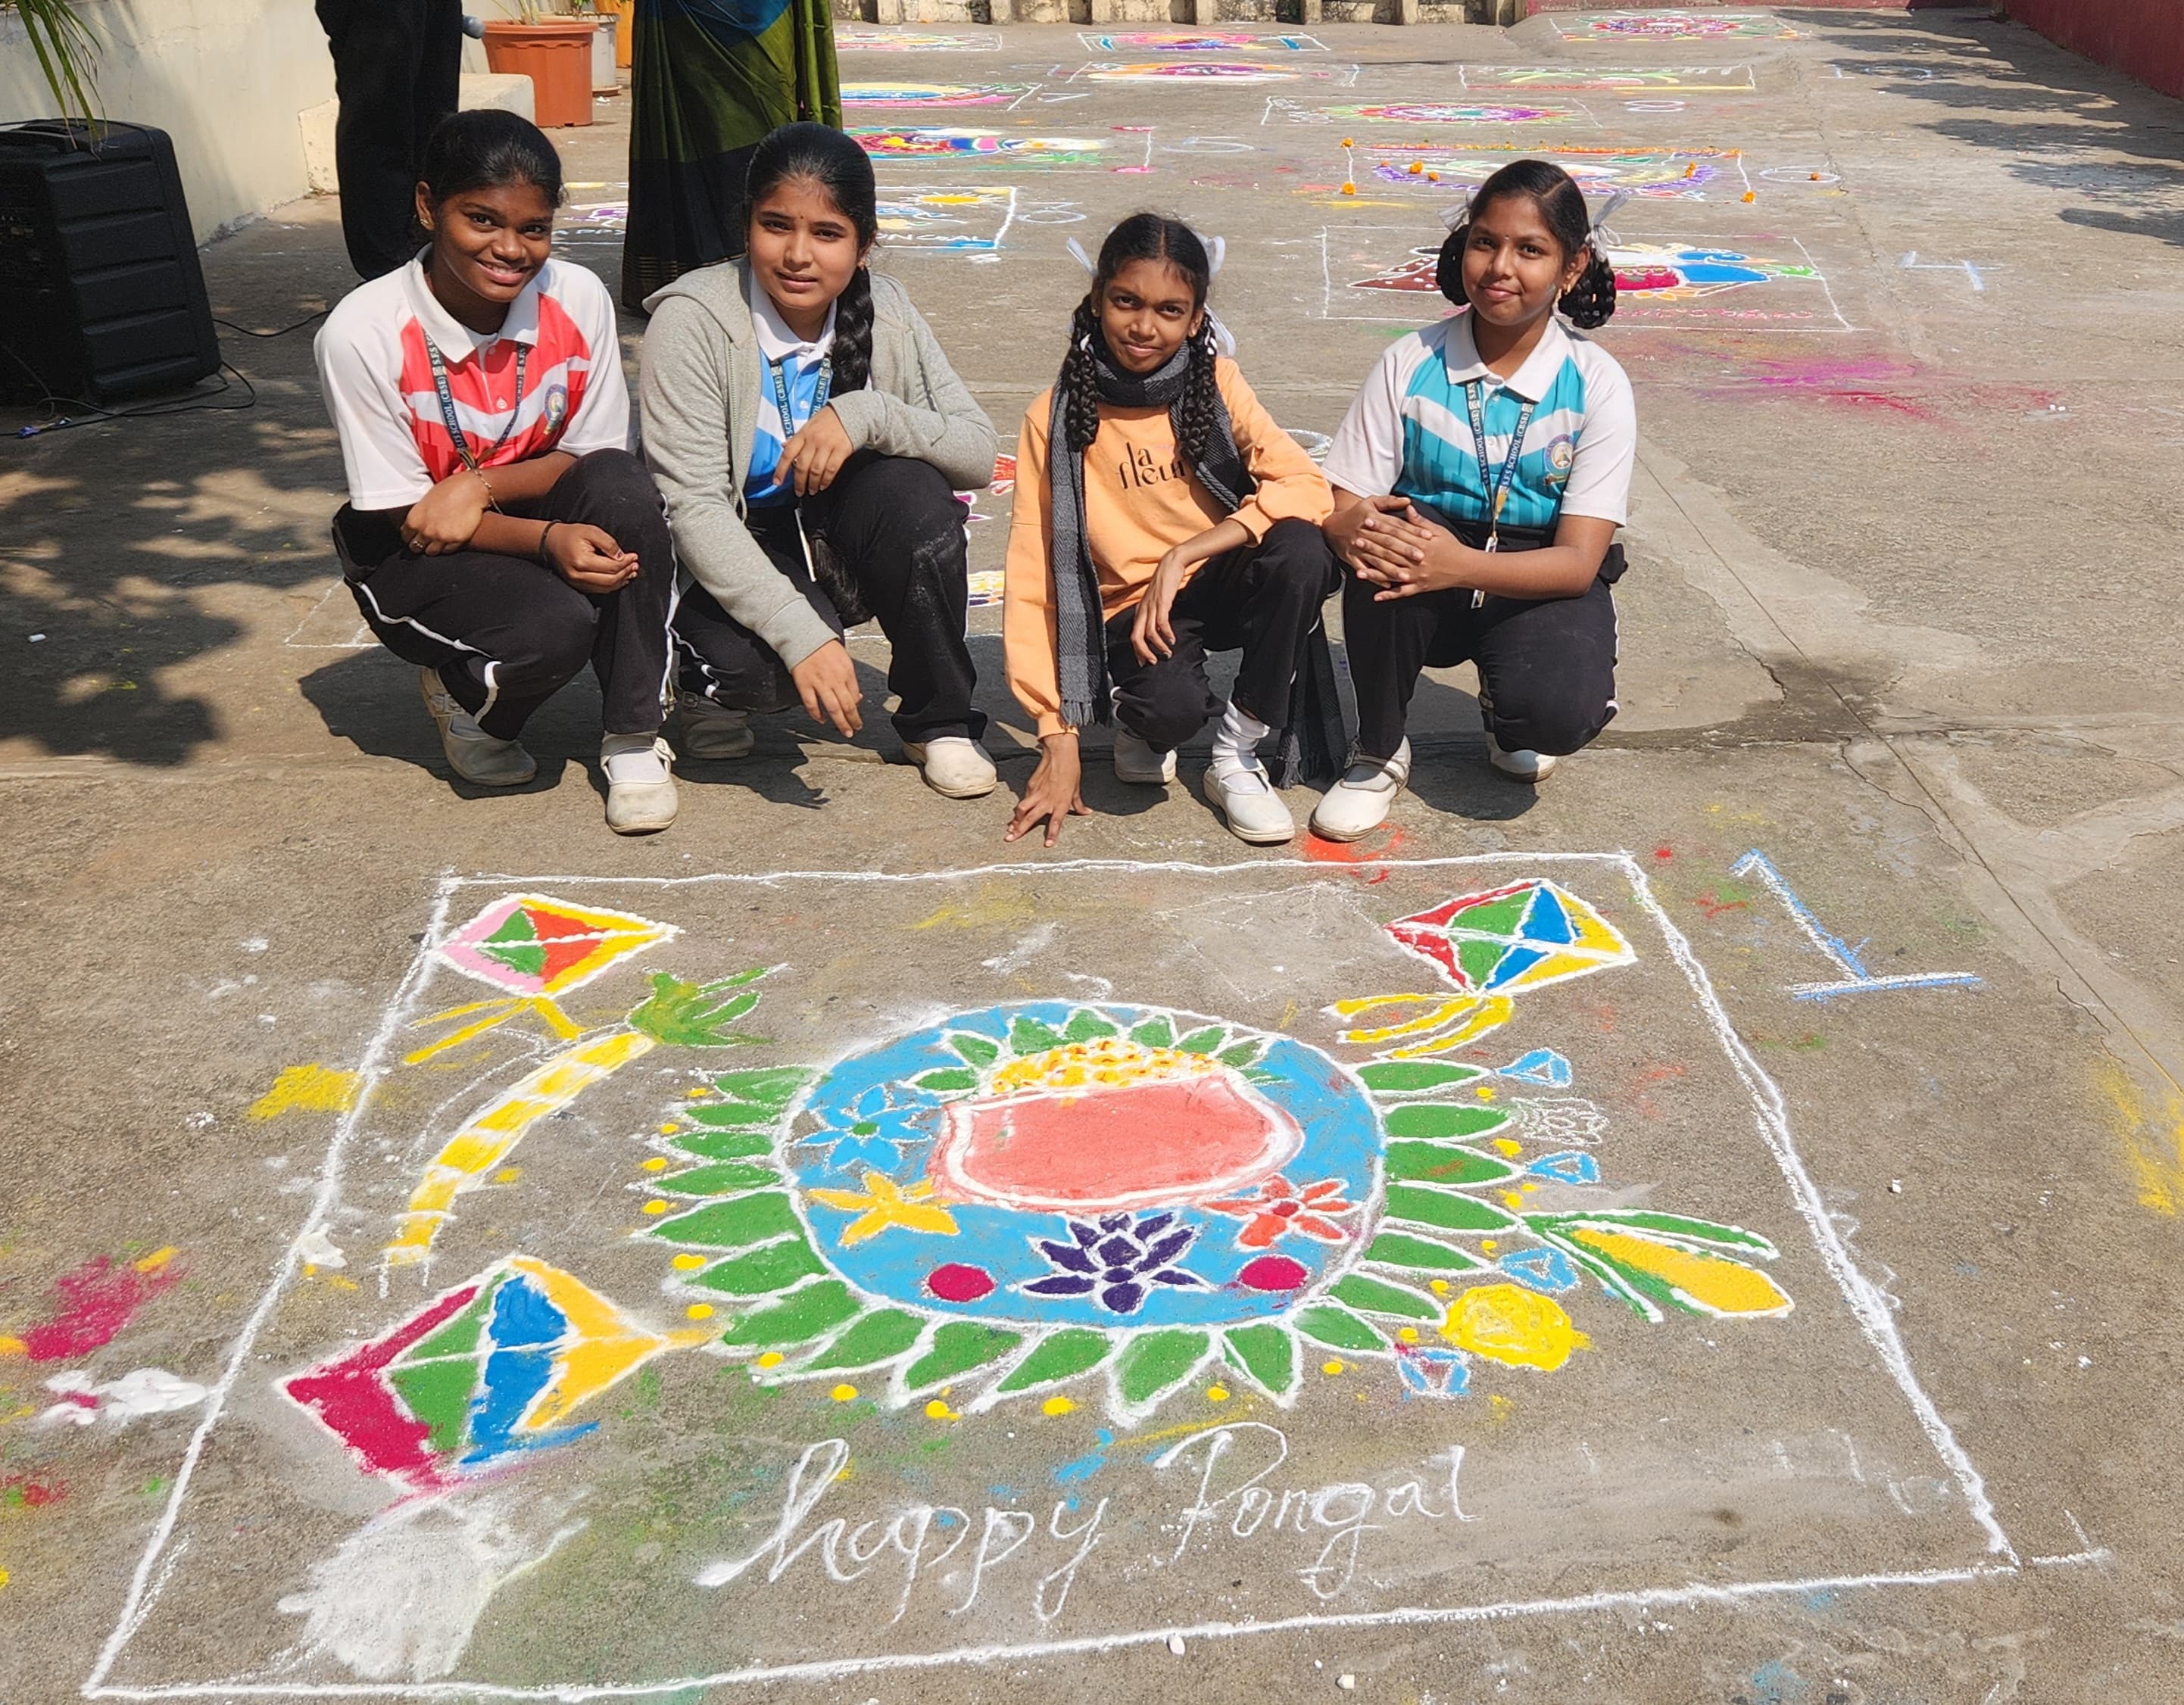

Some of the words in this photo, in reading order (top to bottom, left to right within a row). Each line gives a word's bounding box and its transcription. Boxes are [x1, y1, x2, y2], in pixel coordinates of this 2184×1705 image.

[443, 403, 460, 435] SCHOOL
[780, 402, 793, 435] SCHOOL
[1475, 435, 1487, 467] SCHOOL
[1507, 438, 1521, 469] SCHOOL
[1516, 413, 1530, 437] (CBSE)
[1728, 847, 1984, 1005] 1
[692, 1437, 1109, 1624] happy
[1153, 1421, 1484, 1600] Pongal
